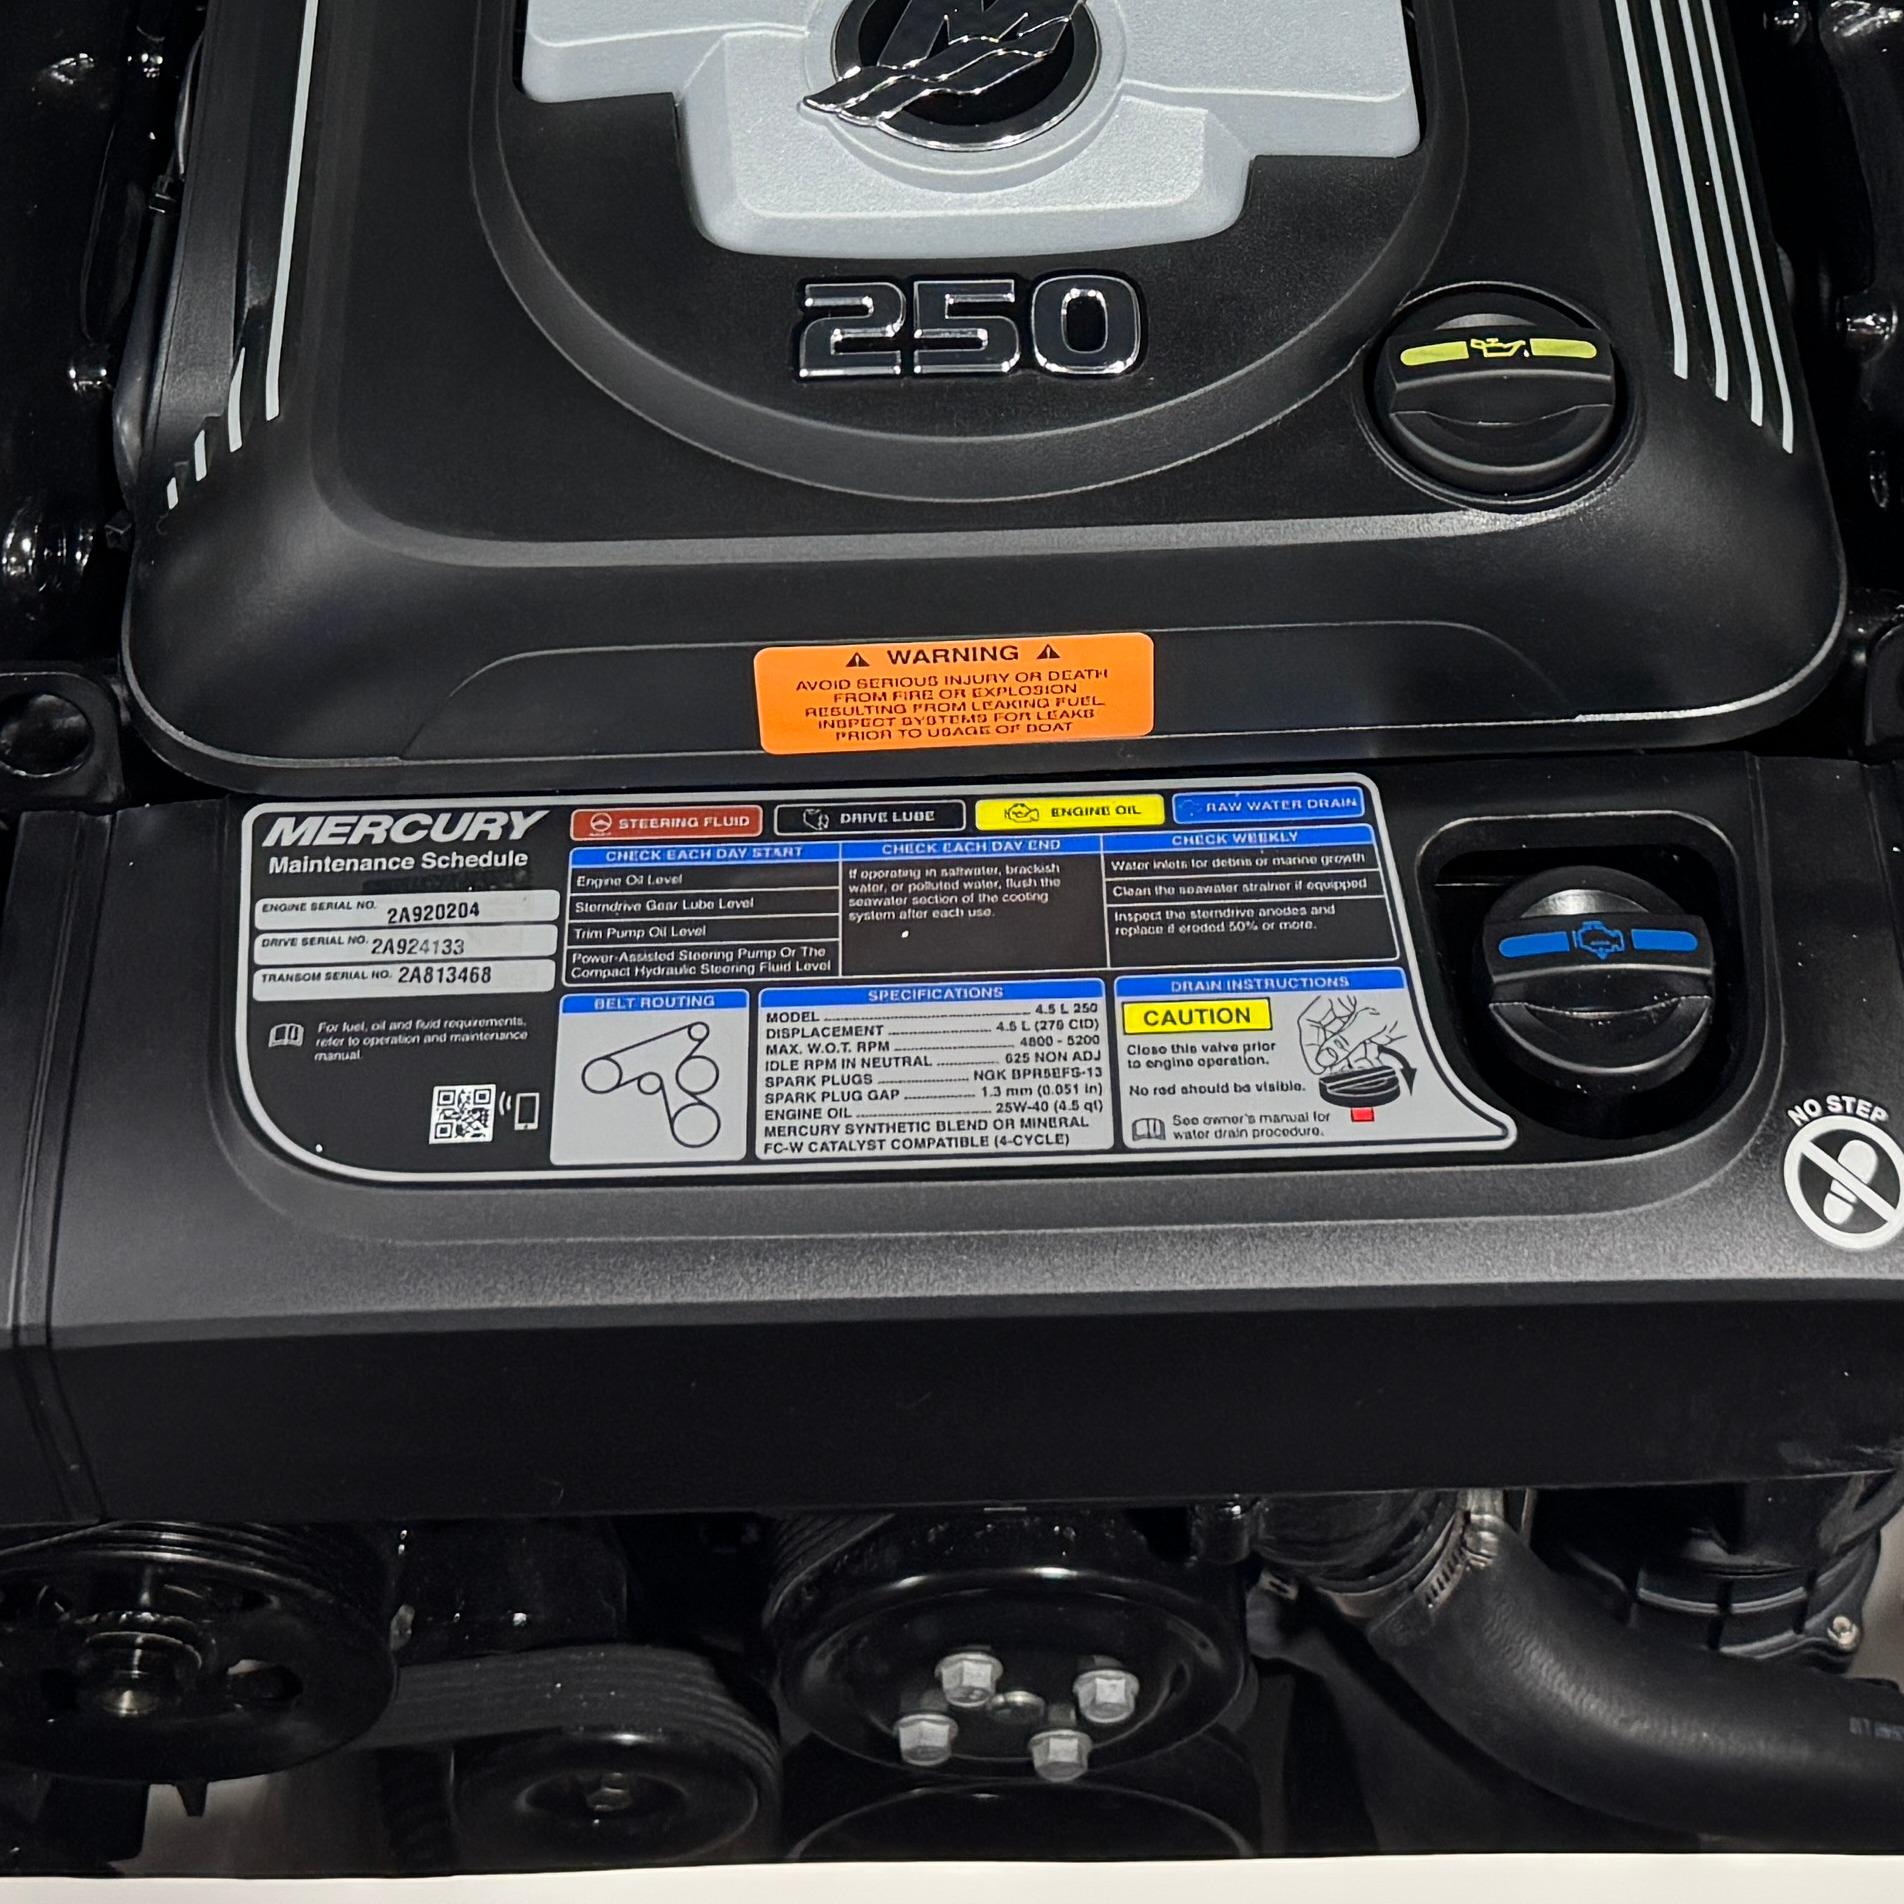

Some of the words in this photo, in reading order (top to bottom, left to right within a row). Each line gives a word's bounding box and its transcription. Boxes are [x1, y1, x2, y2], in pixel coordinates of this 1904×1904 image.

[799, 273, 1143, 378] 250
[886, 646, 1018, 663] WARNING
[796, 679, 850, 690] AVOID
[944, 673, 1009, 684] INJURY
[1015, 671, 1041, 682] OR
[1048, 669, 1107, 680] DEATH
[833, 692, 886, 702] FROM
[892, 689, 933, 700] FIRE
[939, 689, 965, 699] OR
[972, 684, 1076, 697] EXPLOSION
[897, 728, 922, 738] TO
[1051, 806, 1110, 816] ENGINE
[1115, 805, 1141, 814] OIL
[1206, 802, 1241, 811] RAW
[1247, 800, 1302, 810] WATER
[1307, 798, 1357, 808] DRAIN
[619, 817, 698, 828] STEERING
[704, 816, 749, 826] FLUID
[840, 812, 887, 823] DRIVE
[892, 811, 934, 821] LUBE
[261, 811, 549, 846] MERCURY
[1172, 835, 1226, 844] CHECK
[1232, 832, 1297, 842] WEEKLY
[605, 850, 660, 861] CHECK
[666, 849, 710, 859] EACH
[716, 848, 746, 858] DAY
[752, 847, 801, 857] START
[882, 843, 936, 854] CHECK
[942, 842, 986, 852] EACH
[992, 841, 1022, 851] DAY
[1028, 840, 1060, 850] END
[269, 856, 414, 872] Maintenance
[421, 851, 527, 868] Schedule
[1255, 858, 1267, 866] or
[961, 892, 973, 903] of
[262, 903, 306, 912] ENGINE
[310, 901, 352, 910] SERIAL
[356, 900, 376, 909] NO.
[387, 902, 479, 923] 2A920204
[574, 928, 602, 938] Trim
[606, 928, 644, 939] Pump
[648, 926, 666, 937] Oil
[1262, 922, 1274, 930] or
[261, 938, 297, 947] DRIVE
[301, 936, 344, 945] SERIAL
[347, 935, 368, 944] NO.
[371, 938, 464, 954] 2A924133
[738, 948, 776, 961] Pump
[780, 946, 795, 957] Or
[801, 946, 825, 956] The
[759, 961, 791, 971] Fluid
[262, 972, 321, 981] TRANSOM
[325, 971, 367, 980] SERIAL
[371, 970, 392, 978] NO.
[398, 966, 491, 983] 2A813468
[1170, 980, 1221, 991] DRAIN
[1226, 976, 1349, 989] INSTRUCTIONS
[867, 987, 1004, 1002] SPECIFICATIONS
[594, 997, 635, 1010] BELT
[640, 995, 715, 1008] ROUTING
[766, 1011, 820, 1022] MODEL
[1035, 1003, 1055, 1014] 4.5
[1060, 1003, 1068, 1014] L
[1073, 1002, 1097, 1013] 250
[1143, 1007, 1250, 1025] CAUTION
[317, 1022, 338, 1032] For
[371, 1020, 386, 1030] oil
[389, 1020, 412, 1030] and
[766, 1025, 884, 1038] DISPLACEMENT
[1021, 1020, 1030, 1031] L
[1068, 1018, 1099, 1030] CID)
[348, 1036, 359, 1046] to
[362, 1035, 419, 1046] operation
[423, 1033, 446, 1043] and
[450, 1031, 527, 1041] maintenance
[766, 1044, 802, 1054] MAX.
[807, 1041, 851, 1053] W.O.T.
[857, 1041, 889, 1052] RPM
[1020, 1035, 1053, 1046] 4800
[1067, 1034, 1099, 1045] 5200
[1242, 1041, 1276, 1054] prior
[765, 1059, 798, 1071] IDLE
[804, 1058, 836, 1069] RPM
[841, 1057, 855, 1069] IN
[861, 1056, 932, 1068] NEUTRAL
[1034, 1051, 1067, 1062] NON
[1072, 1050, 1100, 1061] ADJ
[1127, 1059, 1141, 1068] to
[765, 1075, 815, 1087] SPARK
[821, 1073, 872, 1085] PLUGS
[973, 1069, 1006, 1080] NGK
[765, 1091, 816, 1104] SPARK
[821, 1090, 862, 1102] PLUG
[867, 1089, 899, 1100] GAP
[982, 1086, 1001, 1096] 1.3
[1006, 1087, 1032, 1096] mm
[1037, 1083, 1078, 1097] (0.051
[1085, 1082, 1102, 1095] in)
[1129, 1085, 1148, 1095] No
[765, 1108, 821, 1120] ENGINE
[827, 1107, 852, 1118] OIL
[996, 1101, 1048, 1113] 25W-40
[1053, 1100, 1079, 1113] (4.5
[1787, 1099, 1823, 1127] NO
[1826, 1094, 1889, 1122] STEP
[764, 1124, 840, 1136] MERCURY
[845, 1121, 930, 1134] SYNTHETIC
[936, 1119, 987, 1131] BLEND
[993, 1118, 1014, 1130] OR
[1020, 1116, 1089, 1128] MINERAL
[1214, 1128, 1248, 1138] drain
[763, 1142, 803, 1153] FC-W
[808, 1139, 886, 1152] CATALYST
[890, 1136, 989, 1149] COMPATIBLE
[994, 1133, 1069, 1147] (4-CYCLE)
